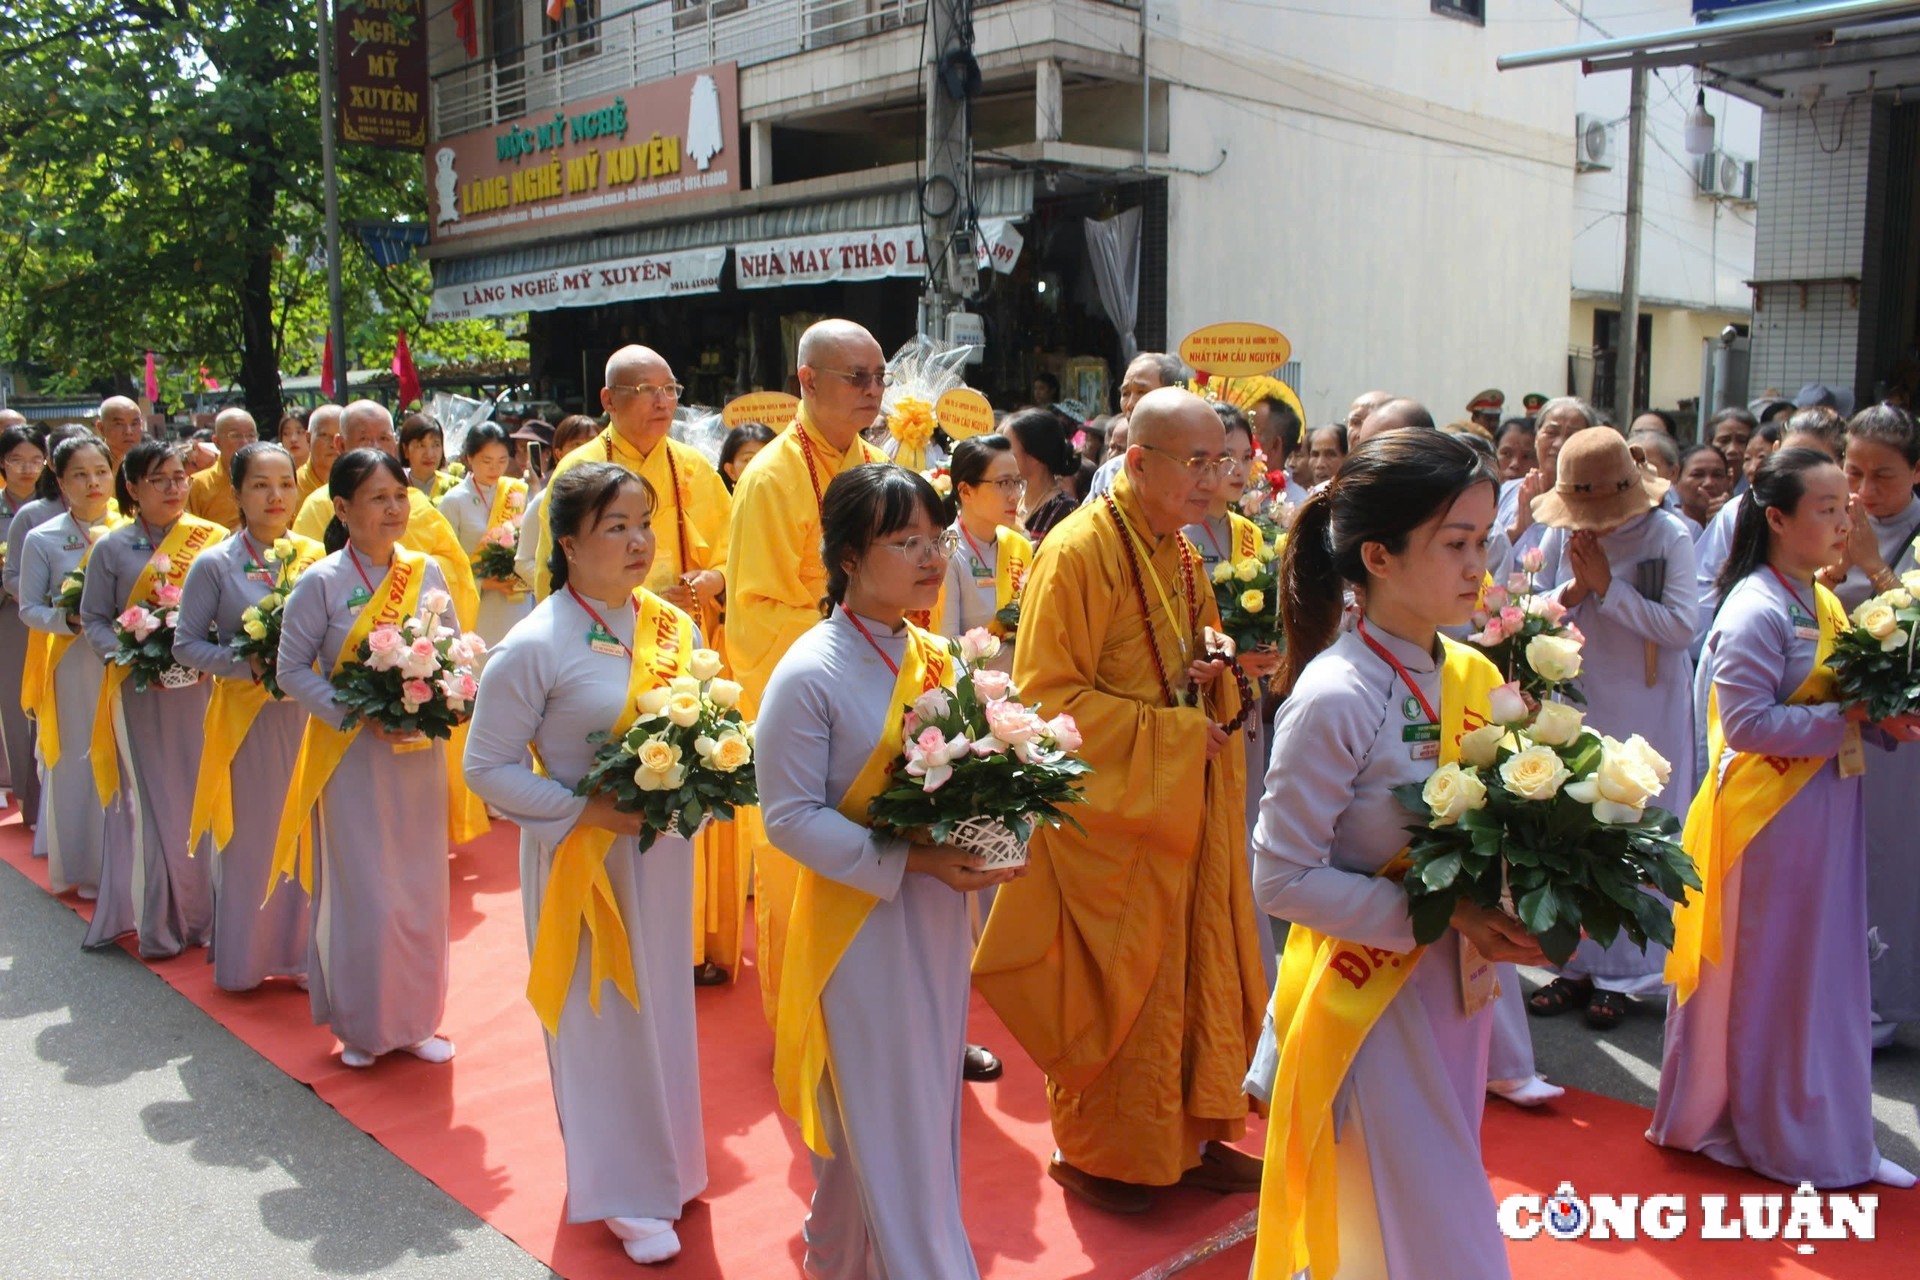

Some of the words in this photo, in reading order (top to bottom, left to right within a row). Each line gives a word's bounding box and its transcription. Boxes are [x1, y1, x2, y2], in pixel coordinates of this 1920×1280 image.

[368, 50, 398, 78] MỸ
[350, 85, 418, 113] XUYÊN
[496, 124, 535, 163] MỘC
[536, 112, 566, 151] MỸ
[570, 96, 628, 140] NGHỆ
[462, 176, 509, 216] LÀNG
[511, 150, 562, 204] NGHỀ
[566, 147, 601, 195] MỸ
[605, 131, 680, 186] XUYÊN
[838, 233, 897, 269] THẢO
[463, 285, 506, 306] LÀNG
[511, 271, 559, 299] NGHỀ
[562, 268, 593, 291] MỸ
[599, 260, 672, 287] XUYÊN
[1189, 348, 1211, 363] NHẤT
[1213, 350, 1229, 363] TÂM
[1250, 350, 1281, 365] NGUYỆN
[651, 604, 680, 654] SIÊU
